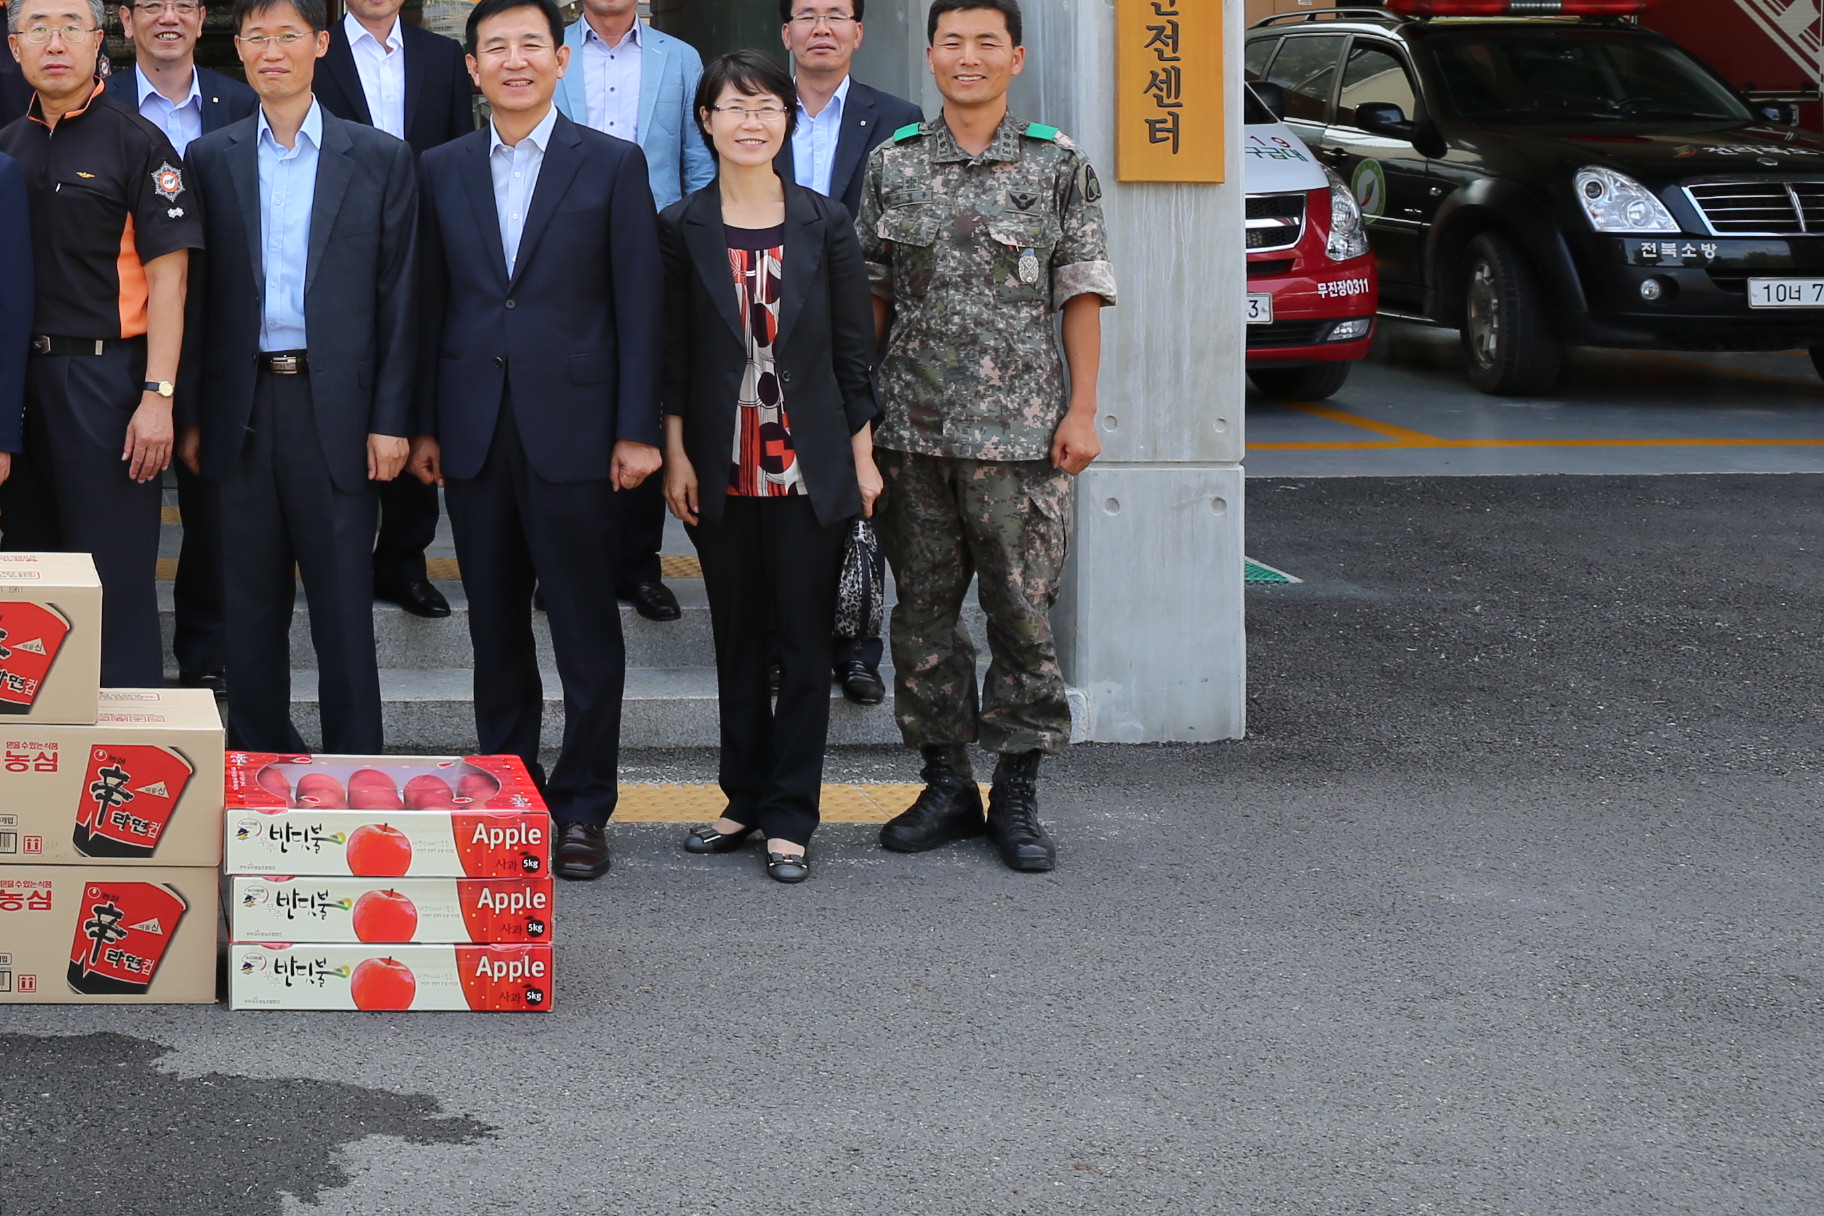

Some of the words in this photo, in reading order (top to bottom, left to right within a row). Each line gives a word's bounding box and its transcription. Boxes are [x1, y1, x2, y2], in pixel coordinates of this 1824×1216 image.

[1640, 242, 1718, 259] 전북소방
[1317, 278, 1369, 299] 무진장0311
[4, 751, 58, 773] 농심
[90, 764, 135, 828] 辛
[471, 822, 542, 850] Apple
[496, 858, 518, 872] 사과
[523, 859, 539, 869] 5kg
[477, 887, 547, 915] Apple
[84, 902, 129, 965] 辛
[500, 923, 523, 936] 사과
[528, 923, 544, 933] 5kg
[475, 955, 545, 983] Apple
[499, 991, 521, 1004] 사과
[527, 992, 542, 1002] 5kg
